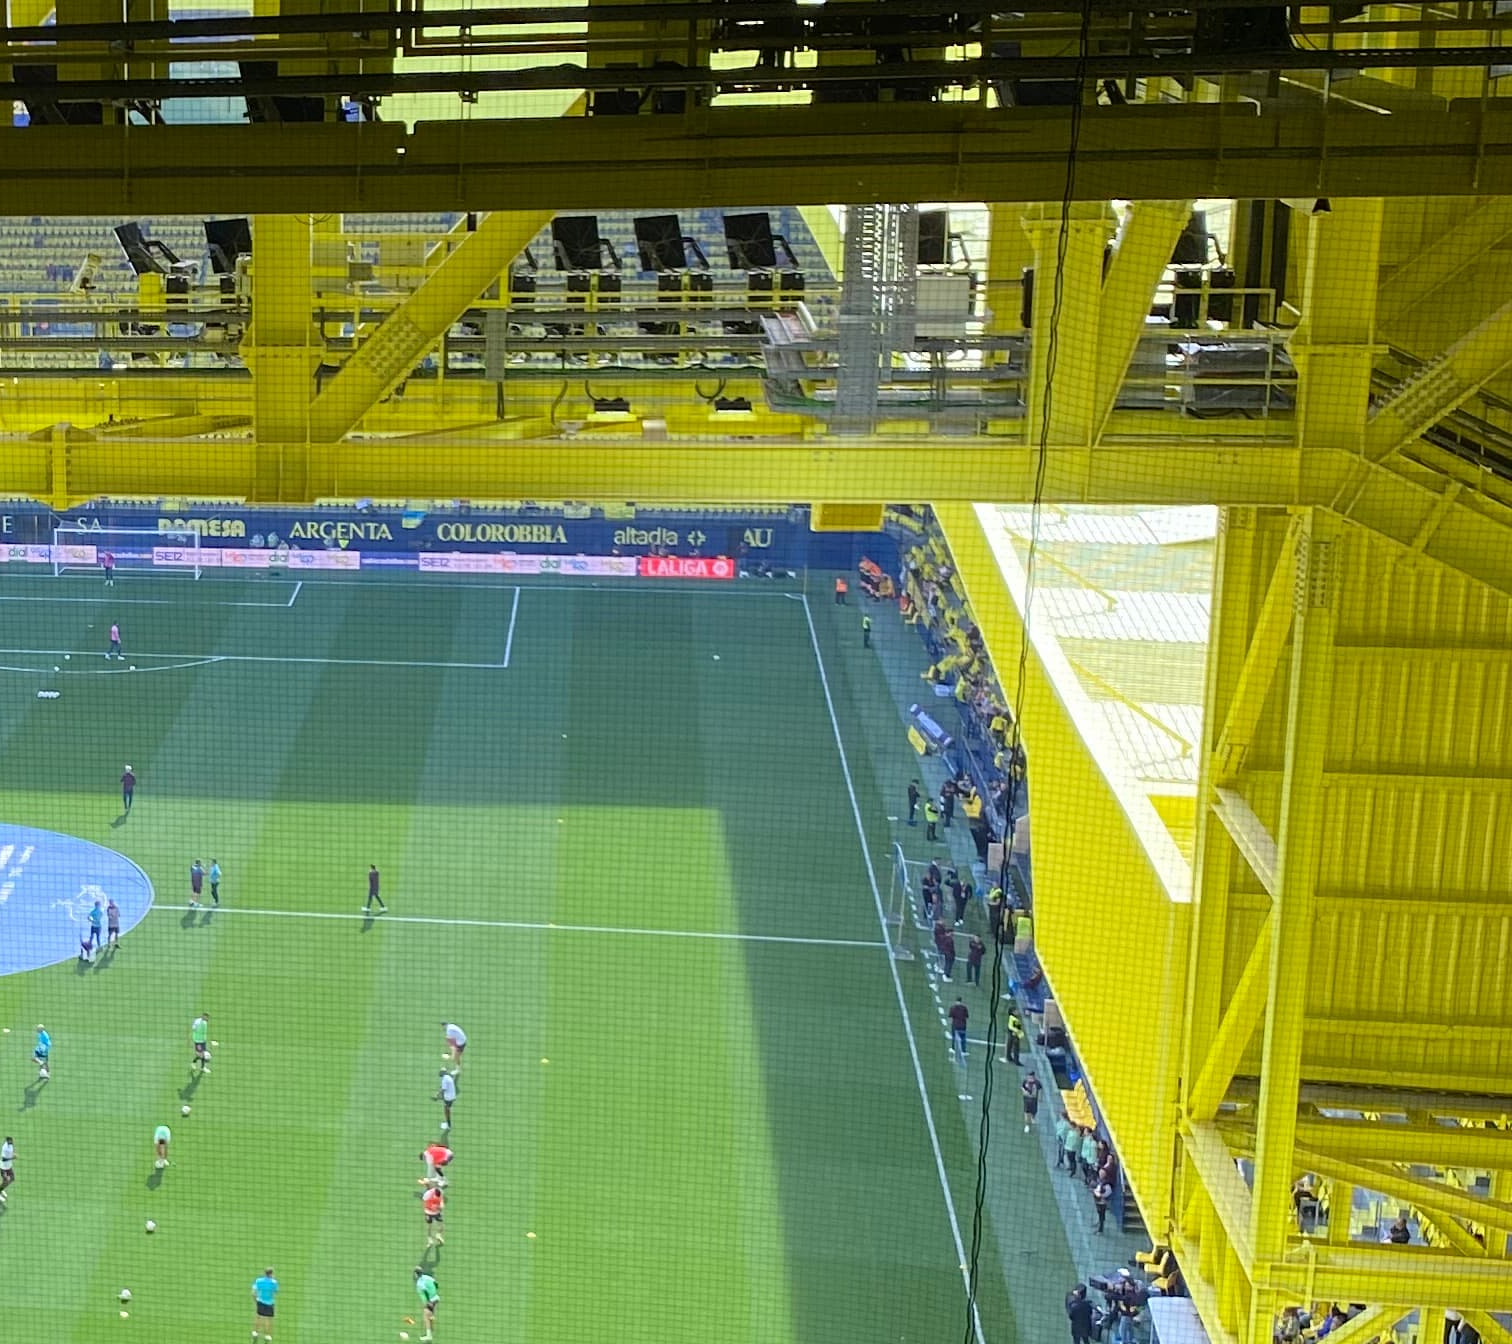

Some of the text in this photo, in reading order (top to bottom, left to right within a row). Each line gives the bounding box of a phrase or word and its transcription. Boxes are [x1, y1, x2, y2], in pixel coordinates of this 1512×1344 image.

[289, 521, 392, 541] ARGENTA
[437, 523, 567, 545] COLOROBBIA
[614, 526, 678, 546] altadia
[647, 559, 708, 575] LALIGA
